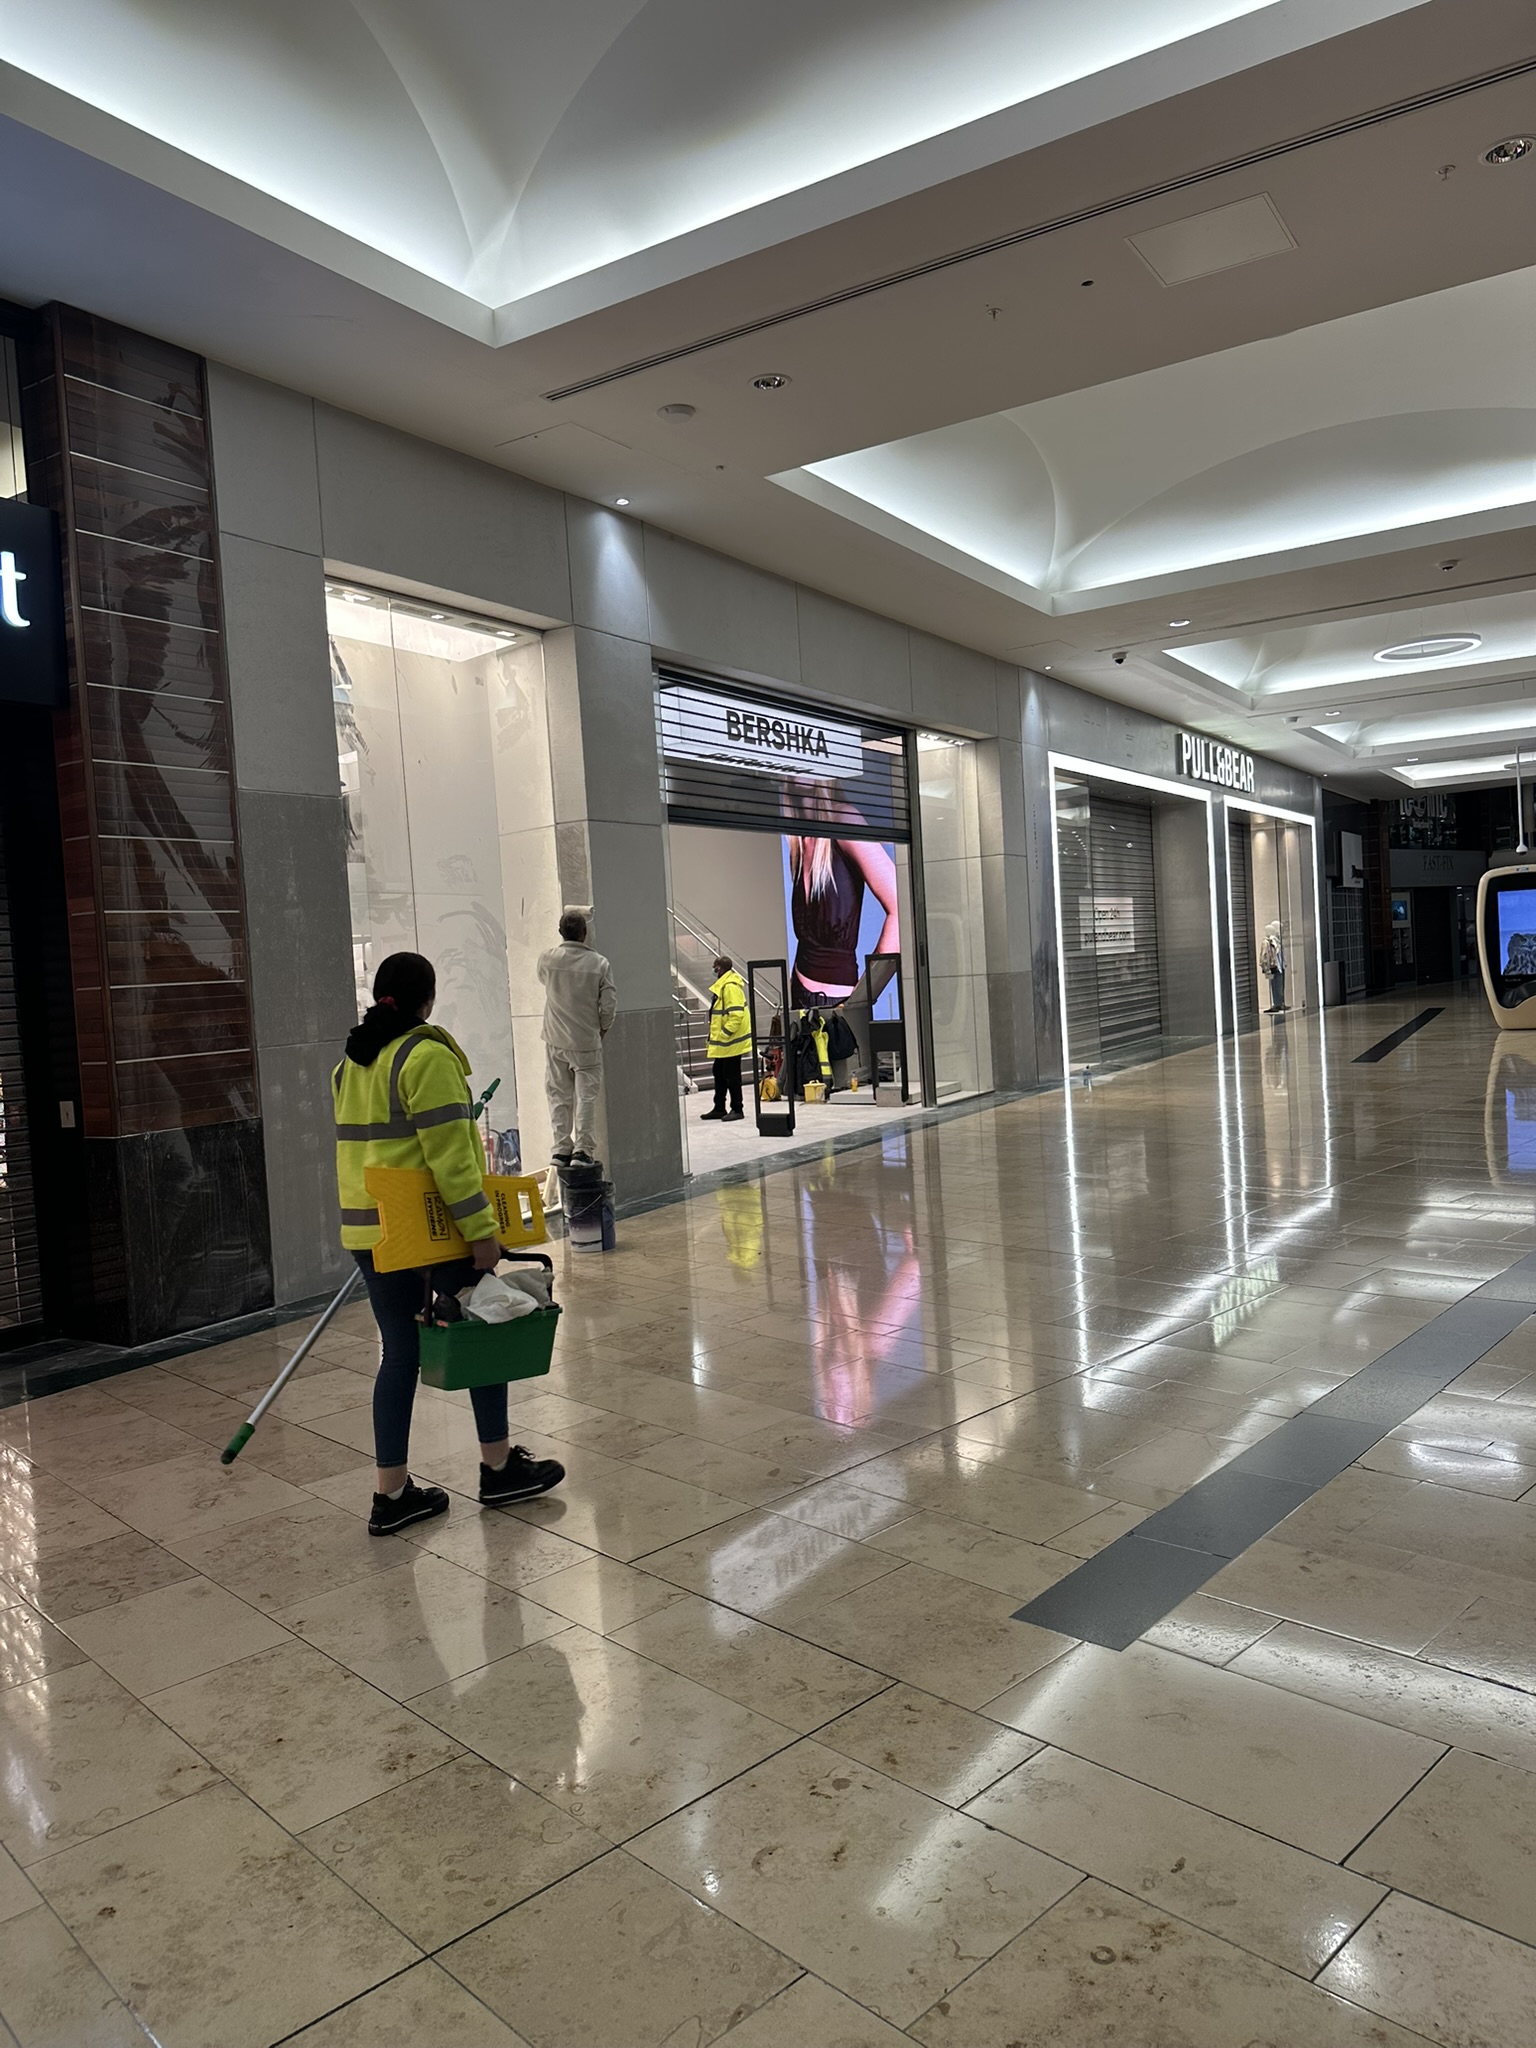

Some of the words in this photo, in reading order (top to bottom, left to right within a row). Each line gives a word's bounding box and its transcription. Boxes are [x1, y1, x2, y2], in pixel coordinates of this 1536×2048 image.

[726, 709, 829, 759] BERSHKA
[1181, 732, 1255, 793] PULL&BEAR
[1423, 855, 1454, 871] FAST-FIX
[426, 1196, 437, 1236] HYGIENE
[496, 1198, 506, 1234] PROGRESS
[500, 1193, 510, 1227] CLEANING
